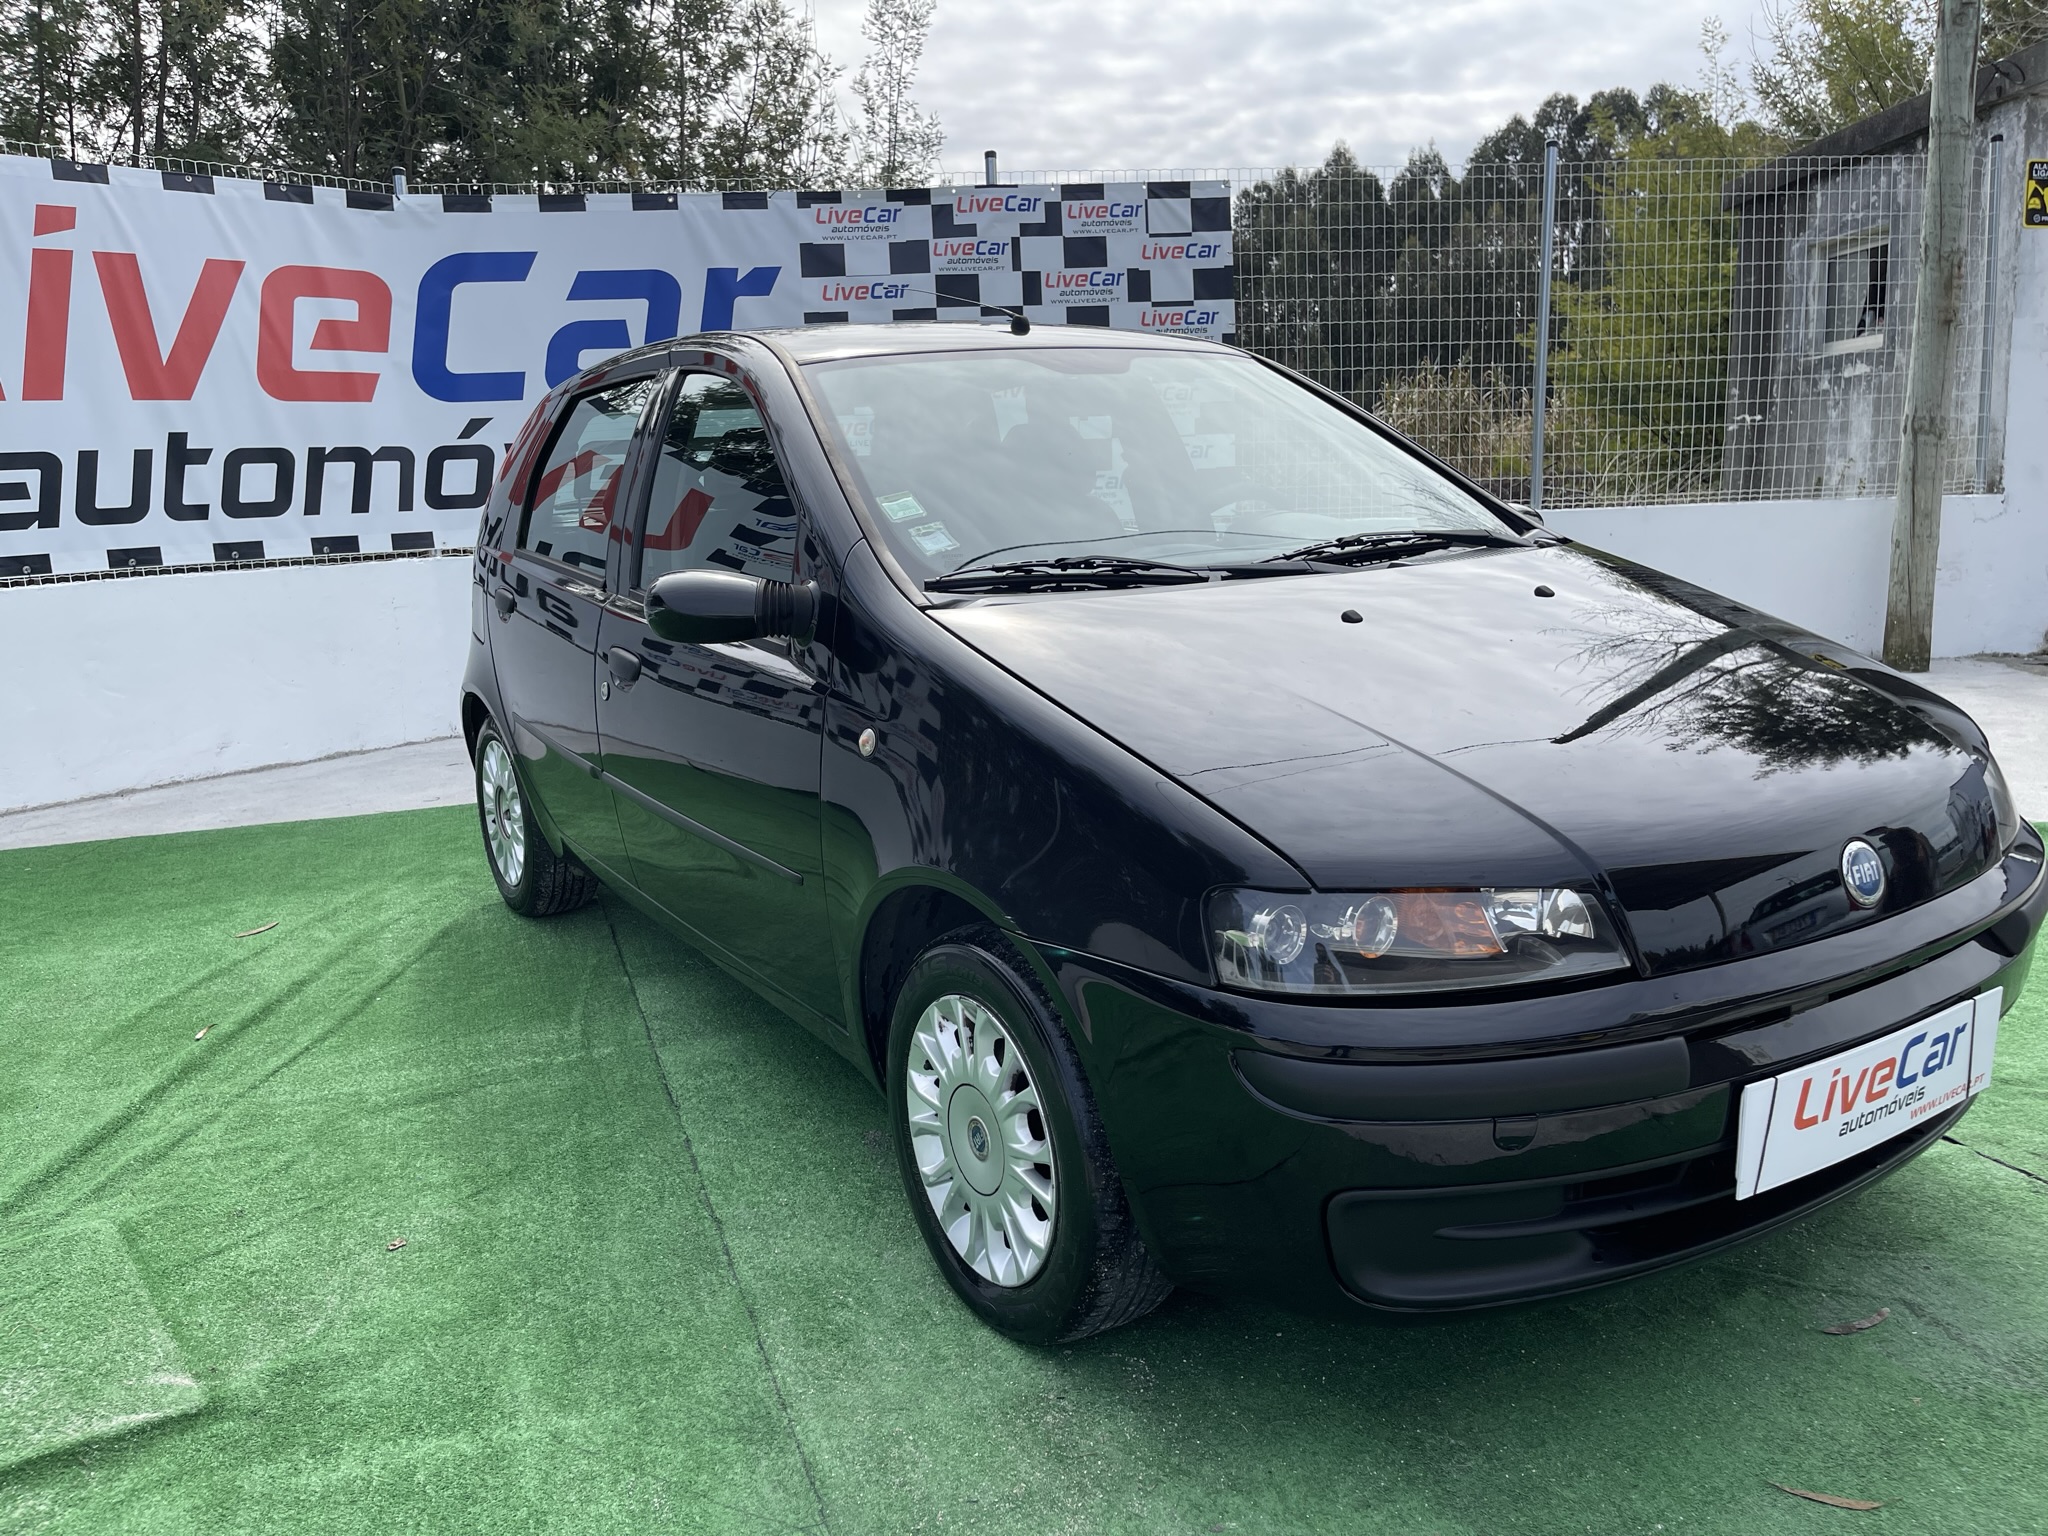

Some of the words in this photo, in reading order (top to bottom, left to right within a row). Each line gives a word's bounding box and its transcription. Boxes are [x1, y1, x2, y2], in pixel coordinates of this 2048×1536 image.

[957, 195, 1041, 213] LiveCar
[1067, 203, 1143, 219] LiveCar
[816, 207, 902, 224] LiveCar
[1081, 219, 1132, 227] automóveis
[832, 224, 890, 233] automóveis
[933, 240, 1009, 256] LiveCar
[1141, 243, 1221, 260] LiveCar
[947, 256, 999, 265] automóveis
[1045, 271, 1125, 288] LiveCar
[822, 282, 909, 301] LiveCar
[1059, 288, 1114, 297] automóveis
[0, 205, 781, 402] iveCar
[1141, 310, 1219, 326] LiveCar
[0, 417, 513, 531] automó
[1852, 861, 1879, 886] FIAT
[1794, 1022, 1968, 1131] LiveCar
[1838, 1085, 1926, 1137] automóveis
